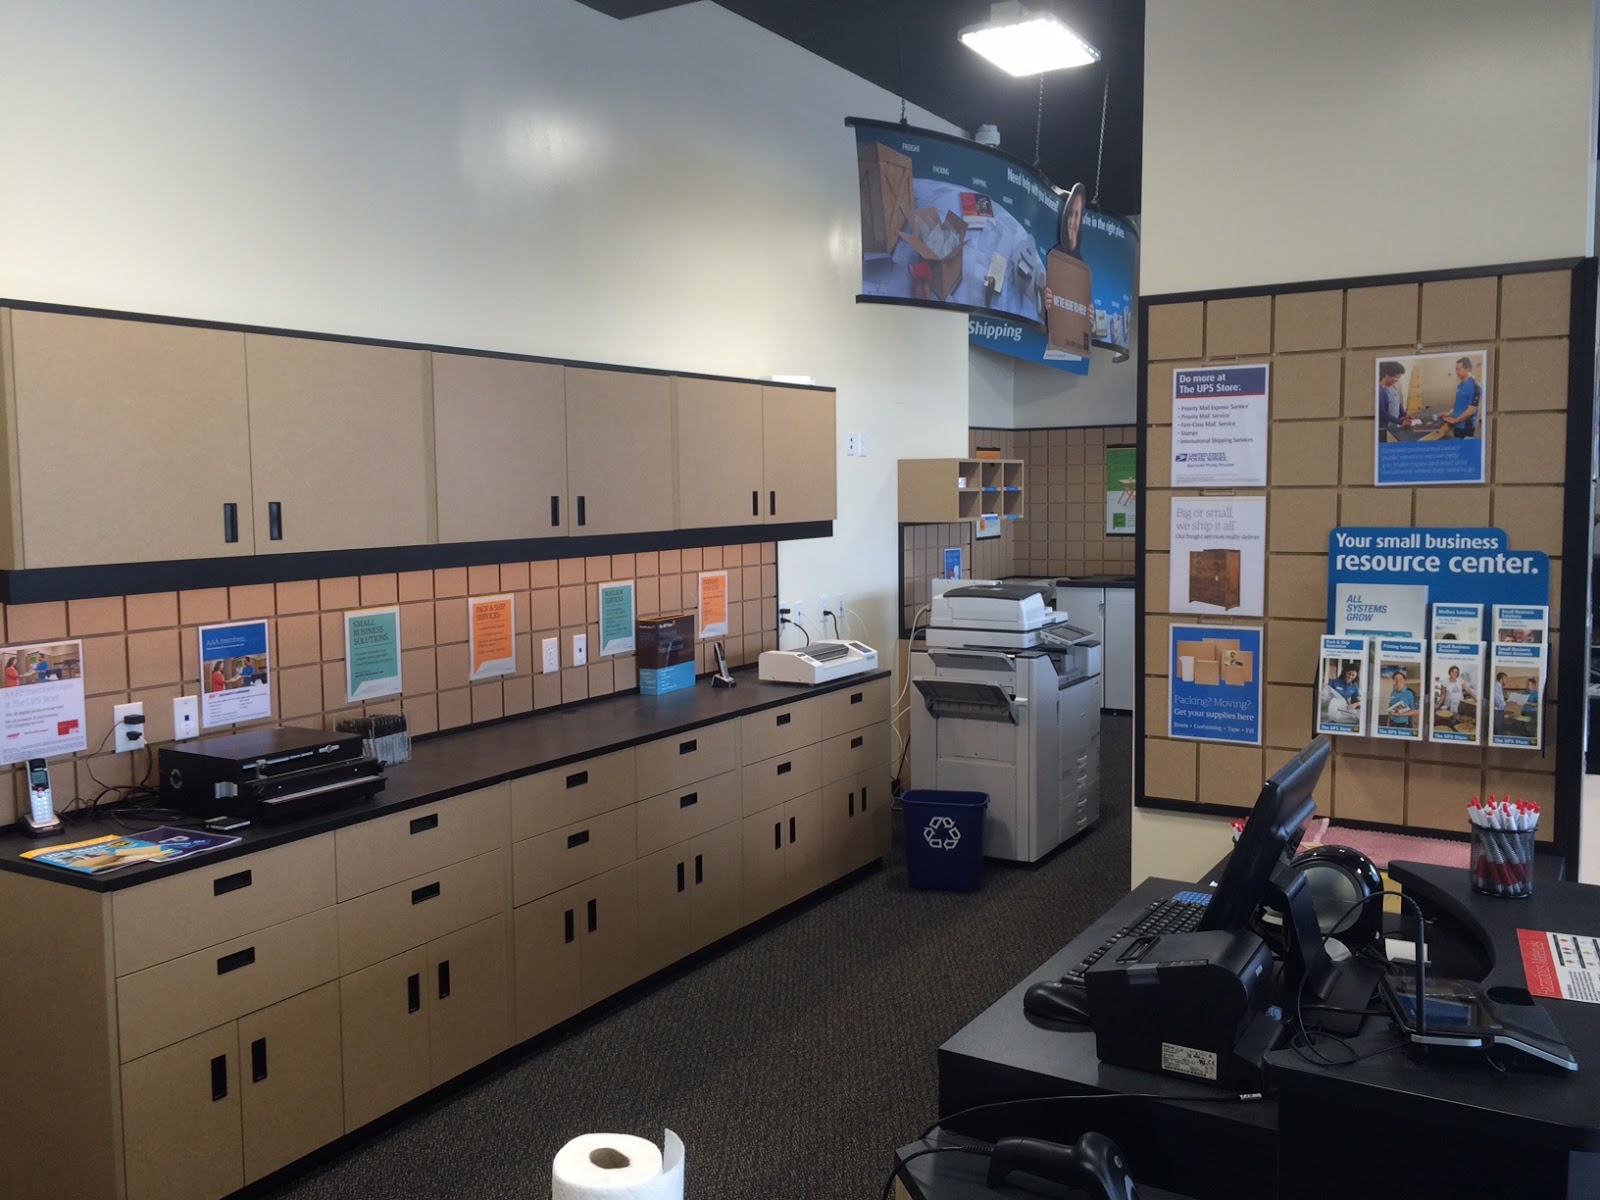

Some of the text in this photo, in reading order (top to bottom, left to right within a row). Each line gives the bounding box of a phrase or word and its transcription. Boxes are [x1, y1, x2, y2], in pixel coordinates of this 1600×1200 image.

[902, 142, 920, 152] FREIGHT
[1008, 167, 1021, 186] Need
[1092, 215, 1097, 228] in
[968, 320, 1023, 341] Shipping
[1180, 373, 1226, 383] Do more at
[1180, 385, 1195, 394] The
[1197, 384, 1214, 393] UPS
[1176, 508, 1192, 519] Big
[1193, 510, 1203, 518] or
[1176, 522, 1190, 530] we
[1192, 521, 1213, 532] ship
[1215, 521, 1221, 530] it
[1336, 533, 1499, 550] Your small business
[1336, 553, 1538, 574] resource center.
[1346, 595, 1363, 603] ALL
[476, 605, 489, 613] PACK
[1346, 604, 1387, 614] SYSTEMS
[476, 612, 500, 620] SERVICES
[1346, 613, 1374, 622] GROW
[353, 619, 375, 628] SMALL
[353, 626, 384, 637] BUSINESS
[354, 634, 389, 645] SOLUTIONS
[1174, 695, 1251, 710] Packing? Moving?
[1188, 710, 1204, 718] your
[1206, 711, 1236, 720] supplies
[1237, 712, 1254, 721] here
